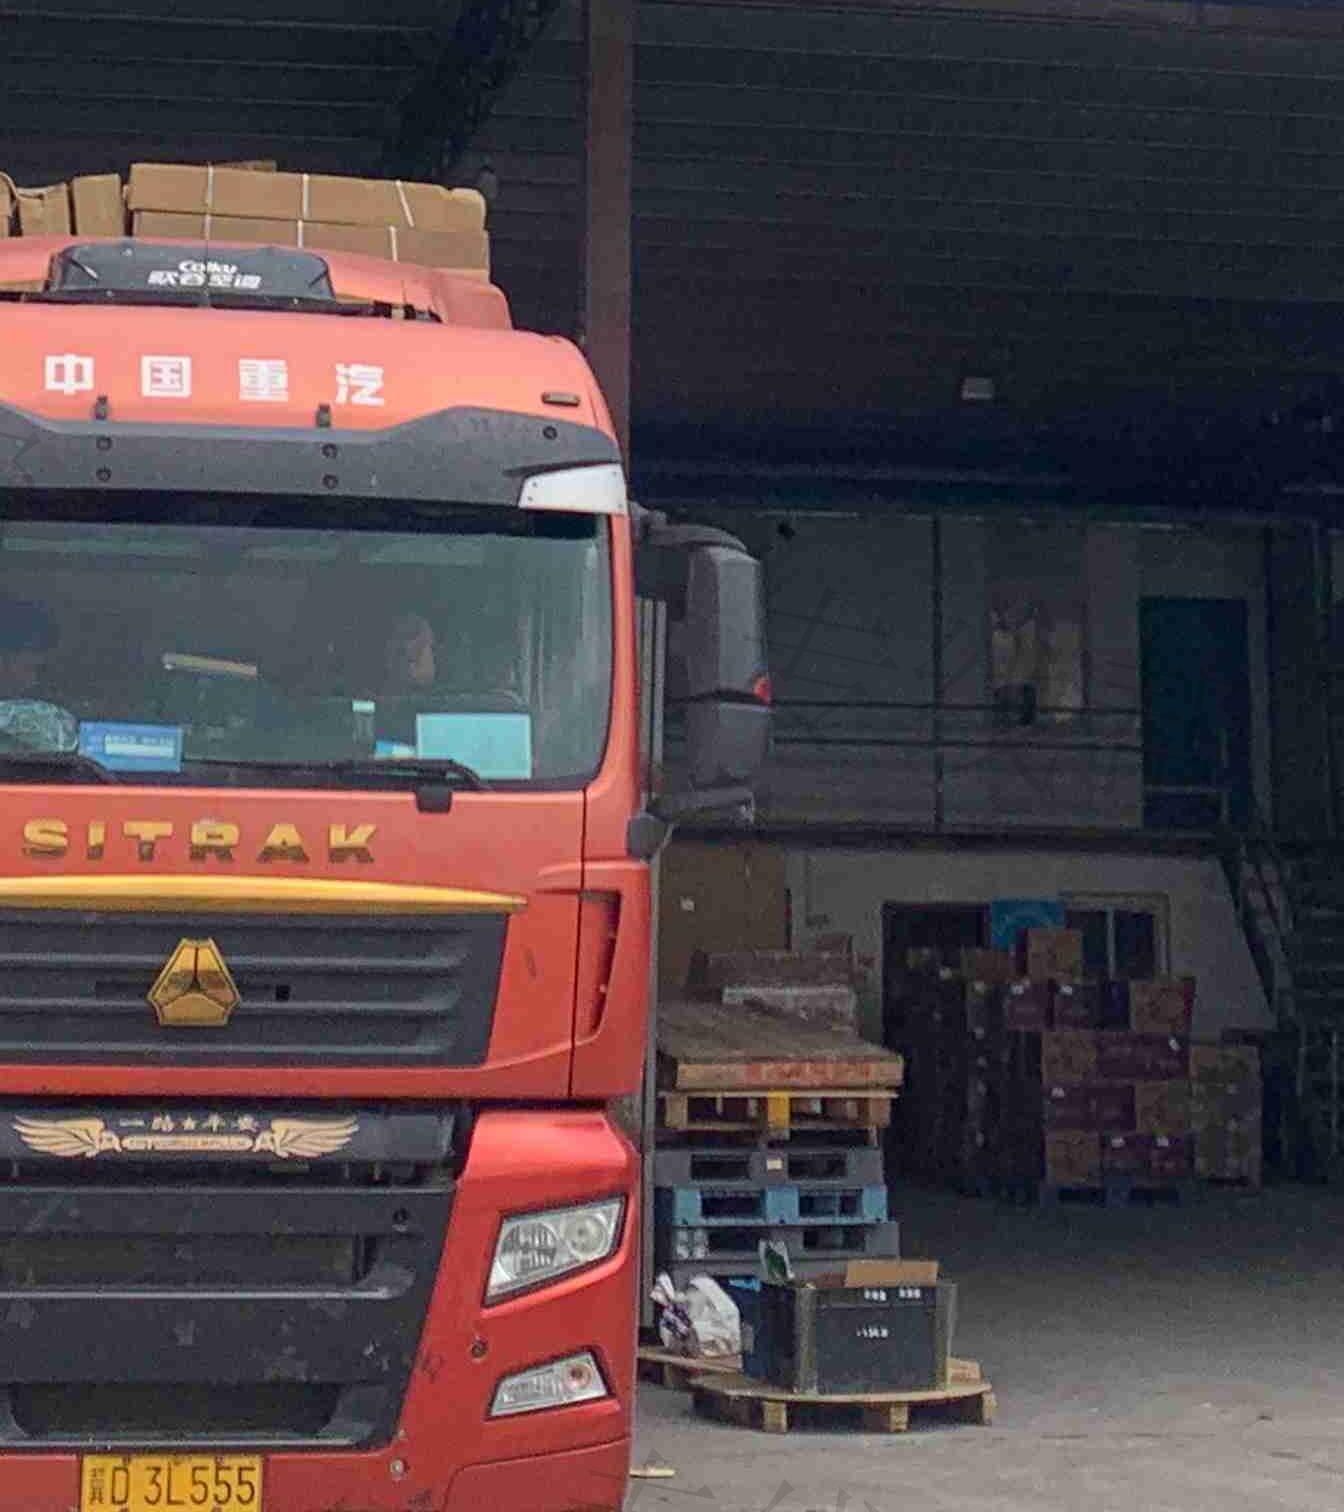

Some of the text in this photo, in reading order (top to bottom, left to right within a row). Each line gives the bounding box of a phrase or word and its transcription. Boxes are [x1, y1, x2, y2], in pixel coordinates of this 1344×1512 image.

[44, 353, 385, 407] 中国重汽
[22, 818, 378, 864] SITRAK
